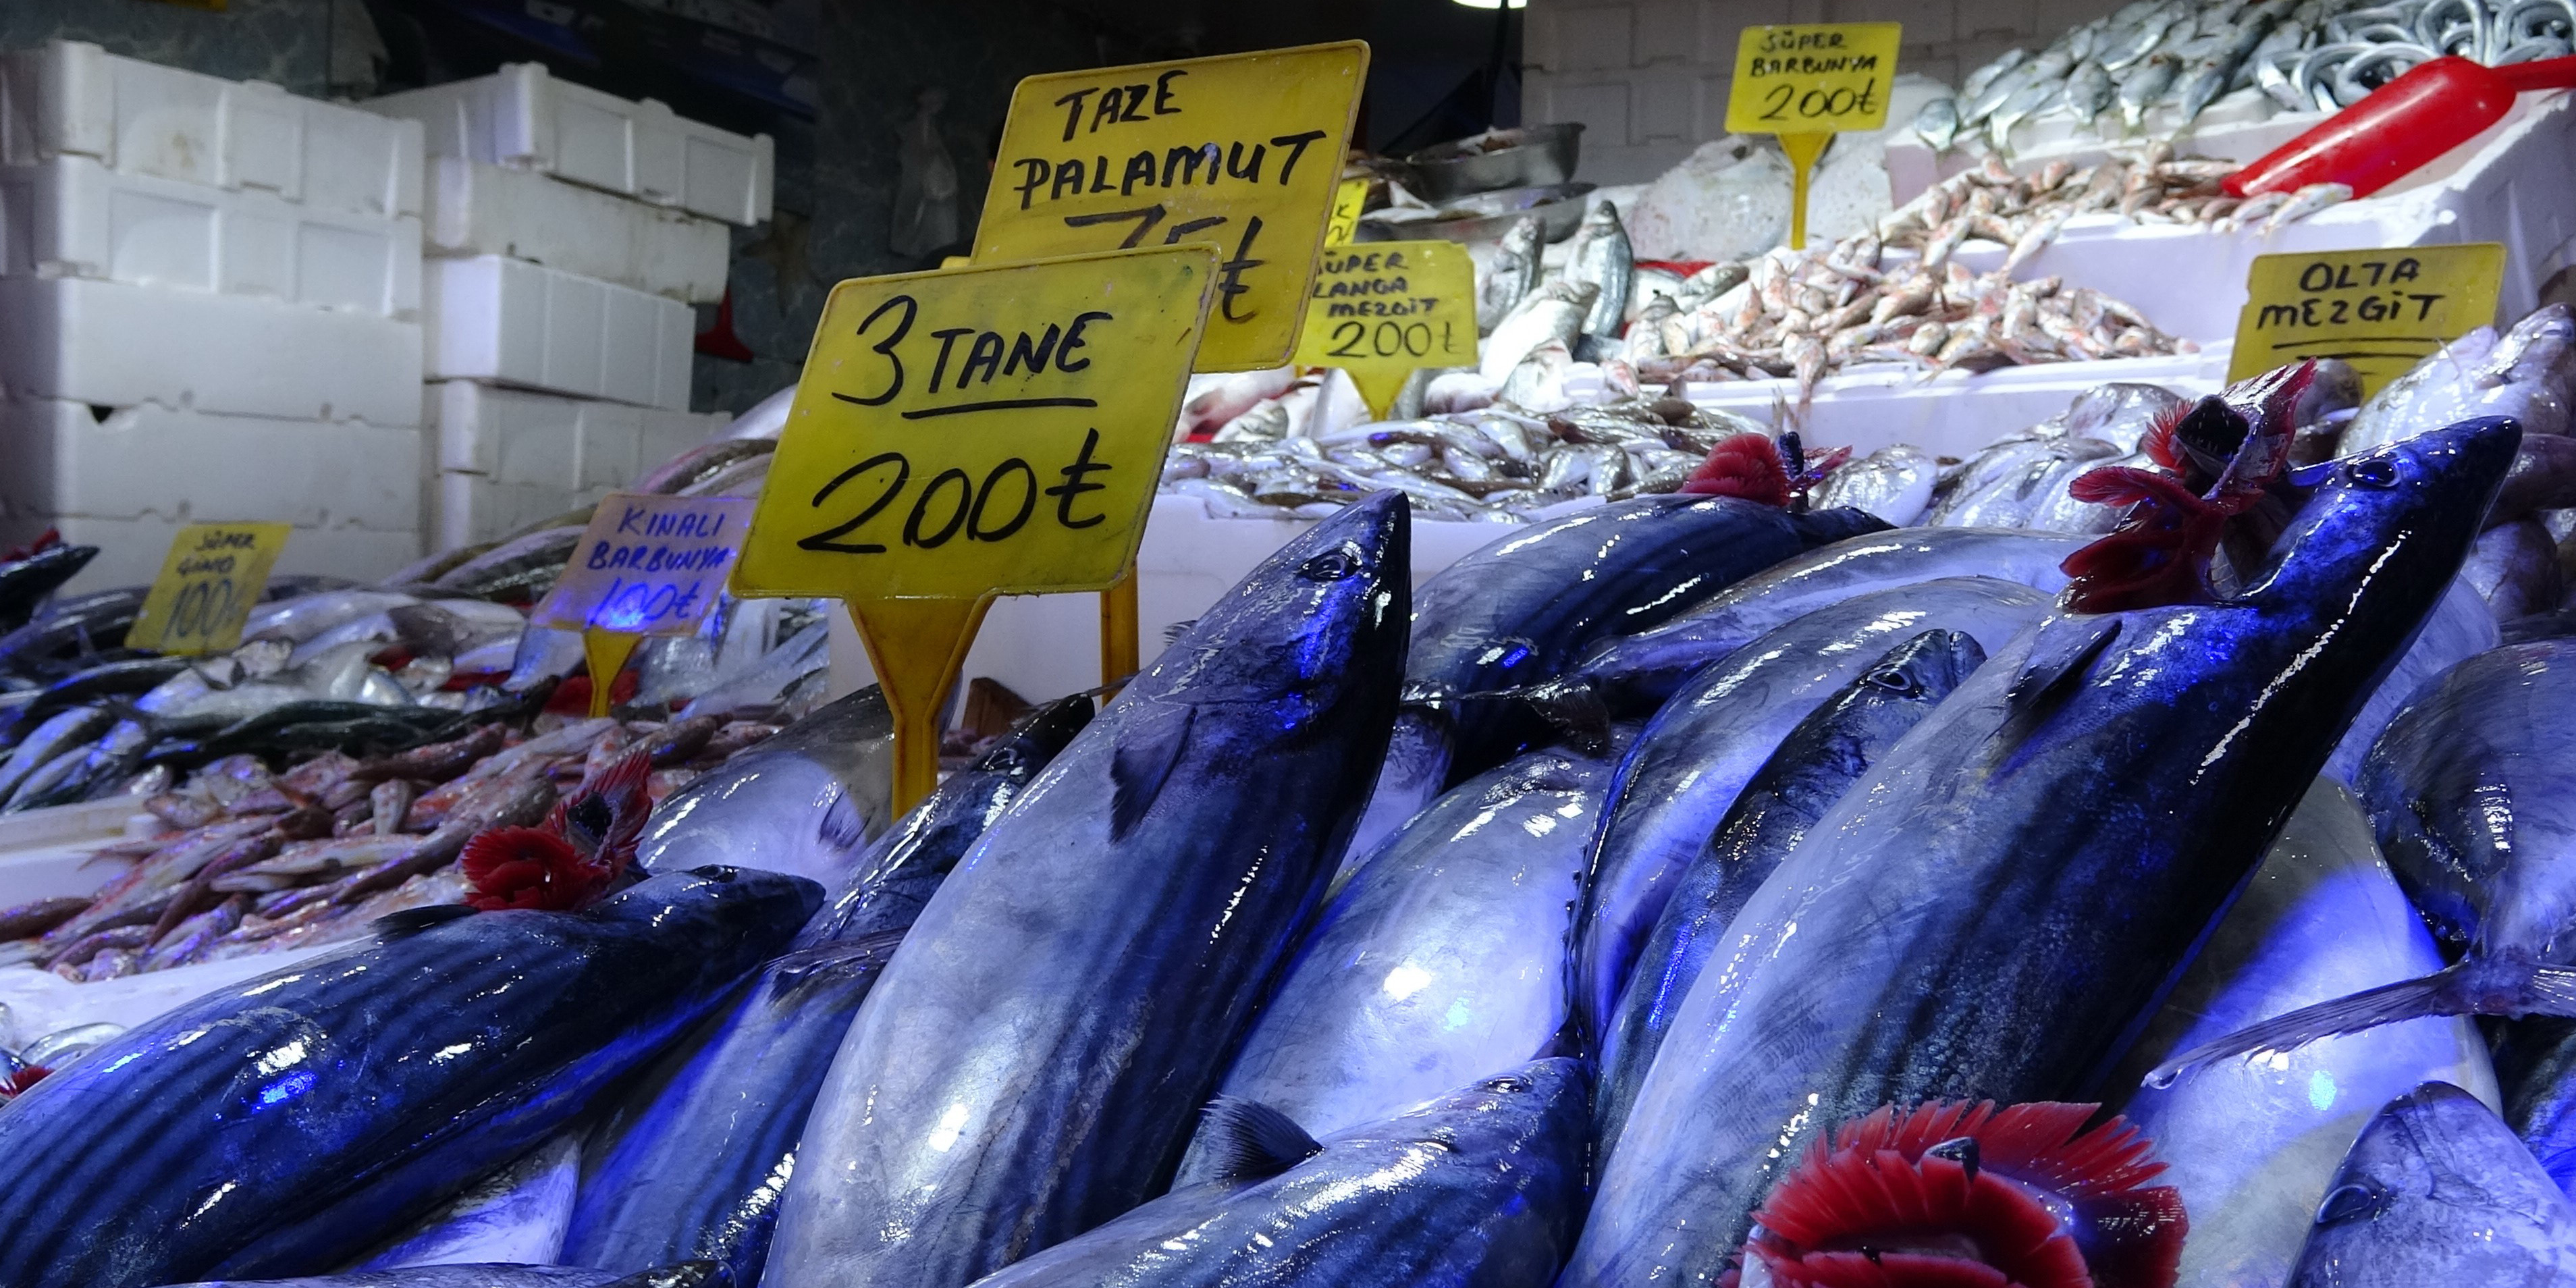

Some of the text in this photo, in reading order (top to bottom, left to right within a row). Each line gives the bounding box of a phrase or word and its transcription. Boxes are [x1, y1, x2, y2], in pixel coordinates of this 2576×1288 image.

[1759, 29, 1847, 53] SÜPER
[1750, 54, 1878, 78] BARBUNYA
[1054, 70, 1188, 142] TAZE
[1013, 130, 1327, 211] PALAMUT
[1318, 250, 1410, 275] ÜPER
[2299, 257, 2421, 292] OLTA
[831, 294, 1113, 406] 3 TANE
[617, 507, 726, 537] KINALI
[587, 541, 730, 572] BARBUNYA
